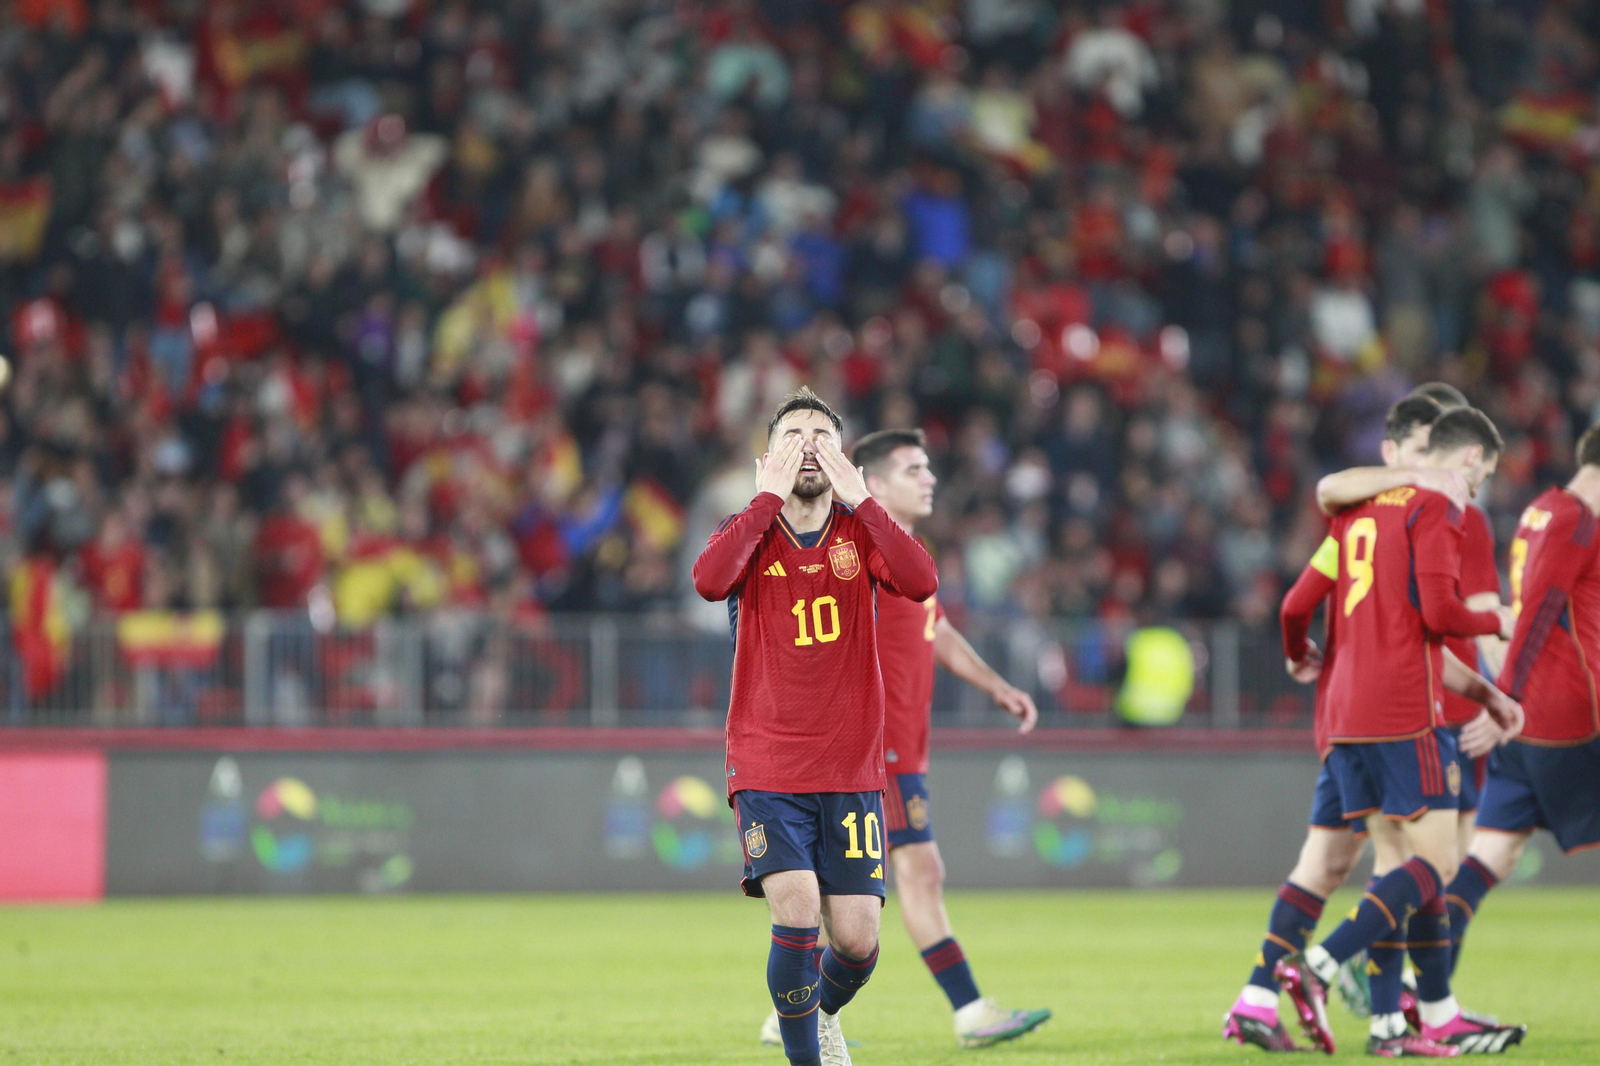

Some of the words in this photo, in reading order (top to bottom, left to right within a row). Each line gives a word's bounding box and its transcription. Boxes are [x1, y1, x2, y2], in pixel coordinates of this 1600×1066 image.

[1344, 517, 1377, 617] 9
[791, 595, 841, 646] 10
[841, 812, 882, 859] 10
